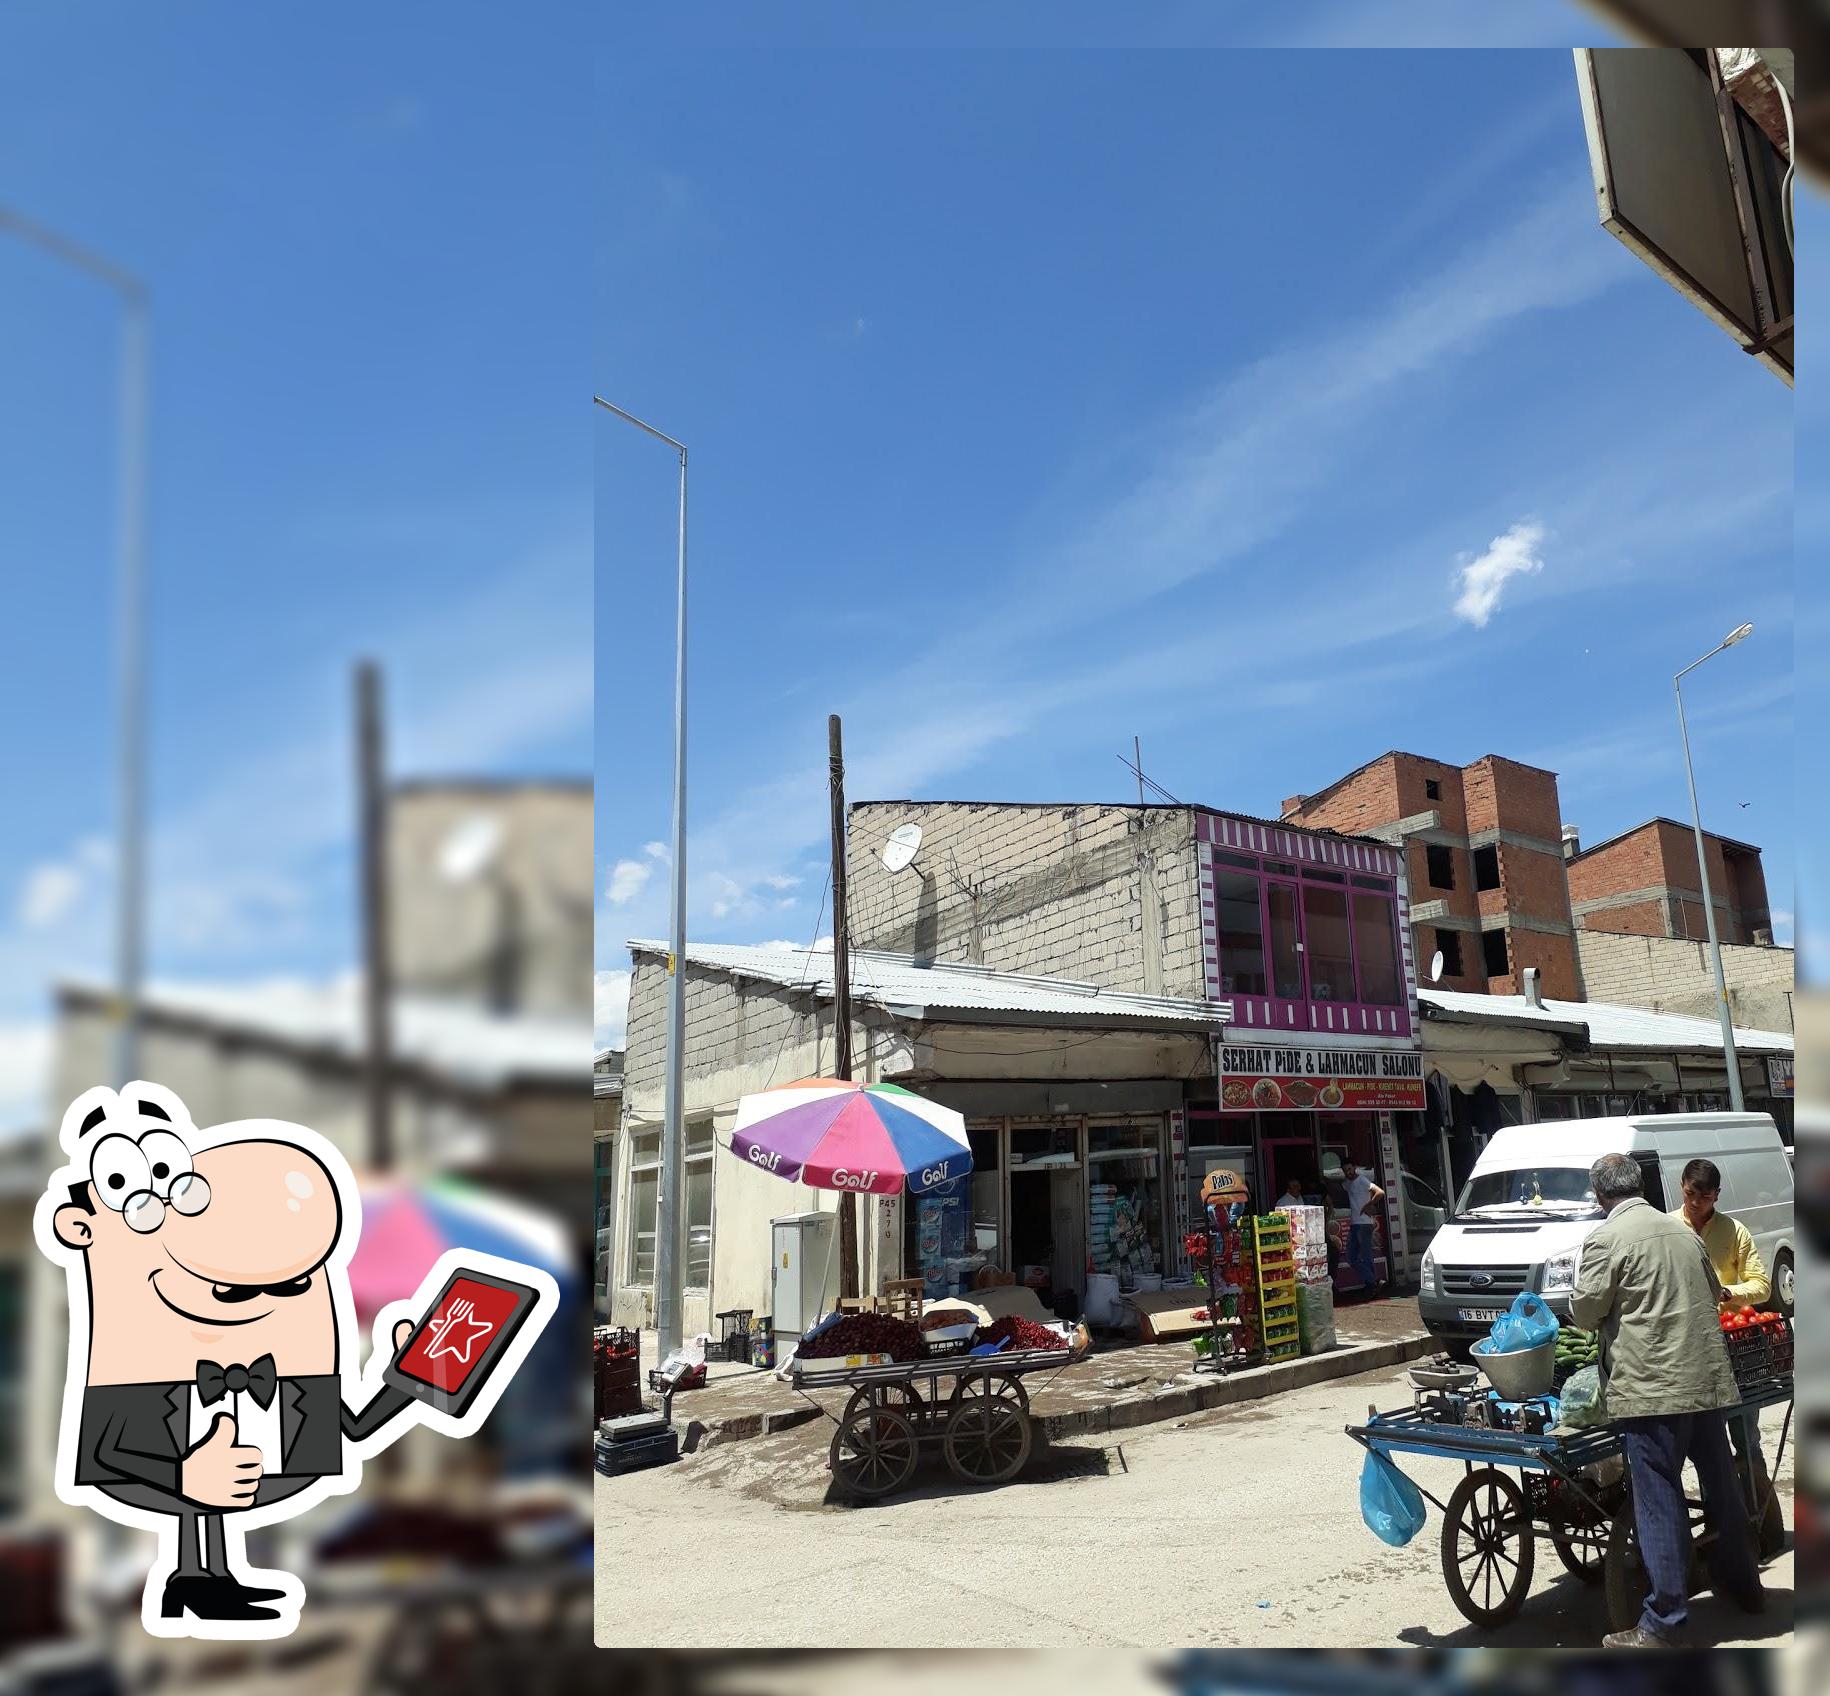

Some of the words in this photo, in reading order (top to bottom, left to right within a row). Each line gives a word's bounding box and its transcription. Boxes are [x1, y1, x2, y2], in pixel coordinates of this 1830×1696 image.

[1222, 1048, 1271, 1073] SERHAT
[1305, 1052, 1315, 1074] &
[1318, 1052, 1376, 1076] LAHMACUN
[1382, 1054, 1421, 1077] SALONU
[748, 1144, 782, 1171] Golf
[831, 1168, 879, 1190] Golf
[921, 1161, 949, 1186] Golf
[1463, 1310, 1473, 1320] 16
[1475, 1310, 1494, 1320] BVT
